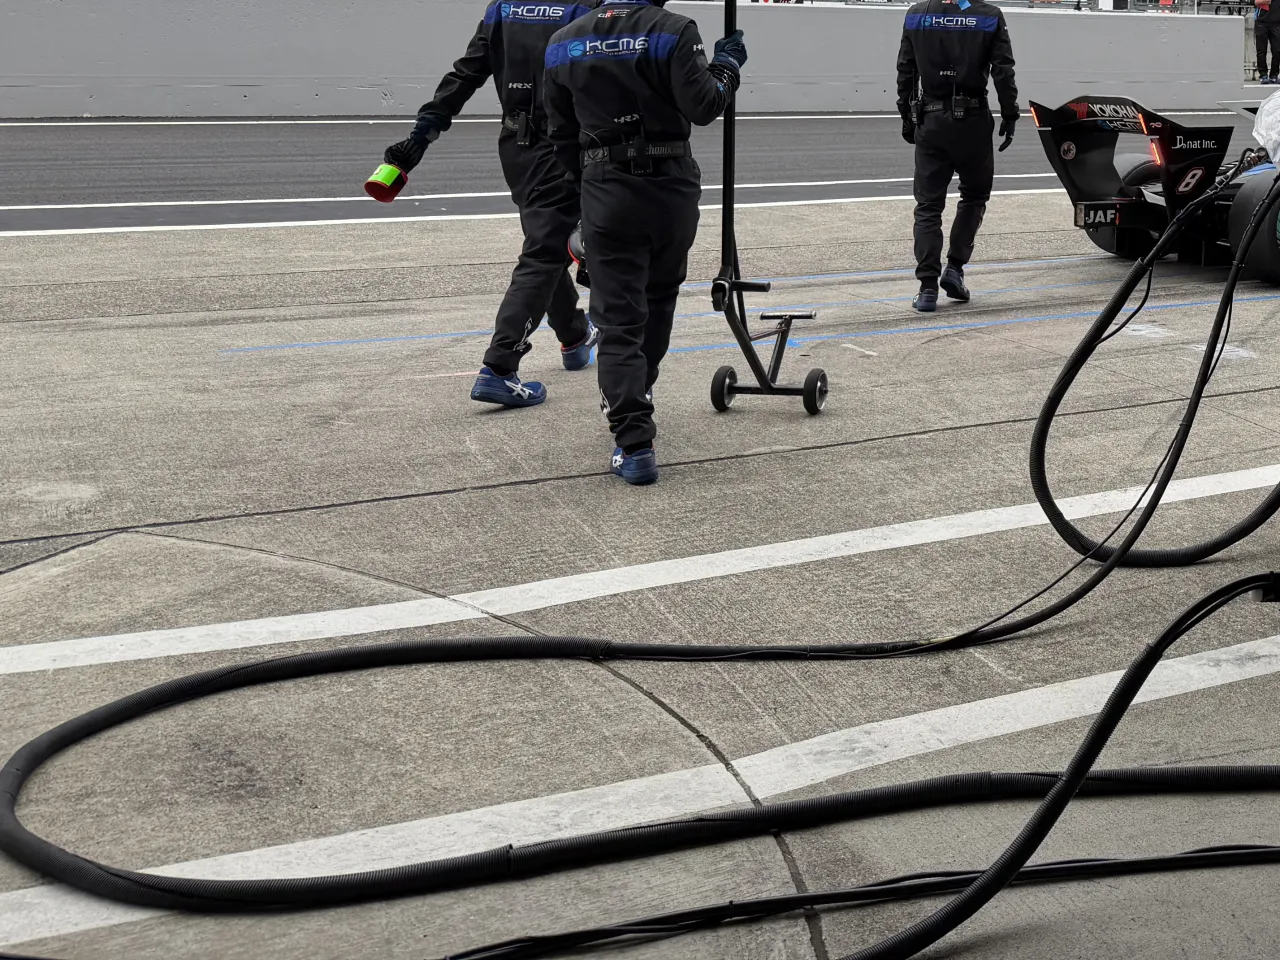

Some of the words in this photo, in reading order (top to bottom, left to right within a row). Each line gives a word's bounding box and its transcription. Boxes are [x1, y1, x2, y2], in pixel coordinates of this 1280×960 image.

[509, 4, 565, 17] KCMG
[932, 16, 977, 25] KCMG
[586, 37, 649, 52] KCMG
[1088, 103, 1139, 119] YOKOHA
[1106, 120, 1143, 131] KCM
[1202, 139, 1217, 149] Inc.
[1177, 168, 1204, 193] 8
[1085, 209, 1116, 224] JAF
